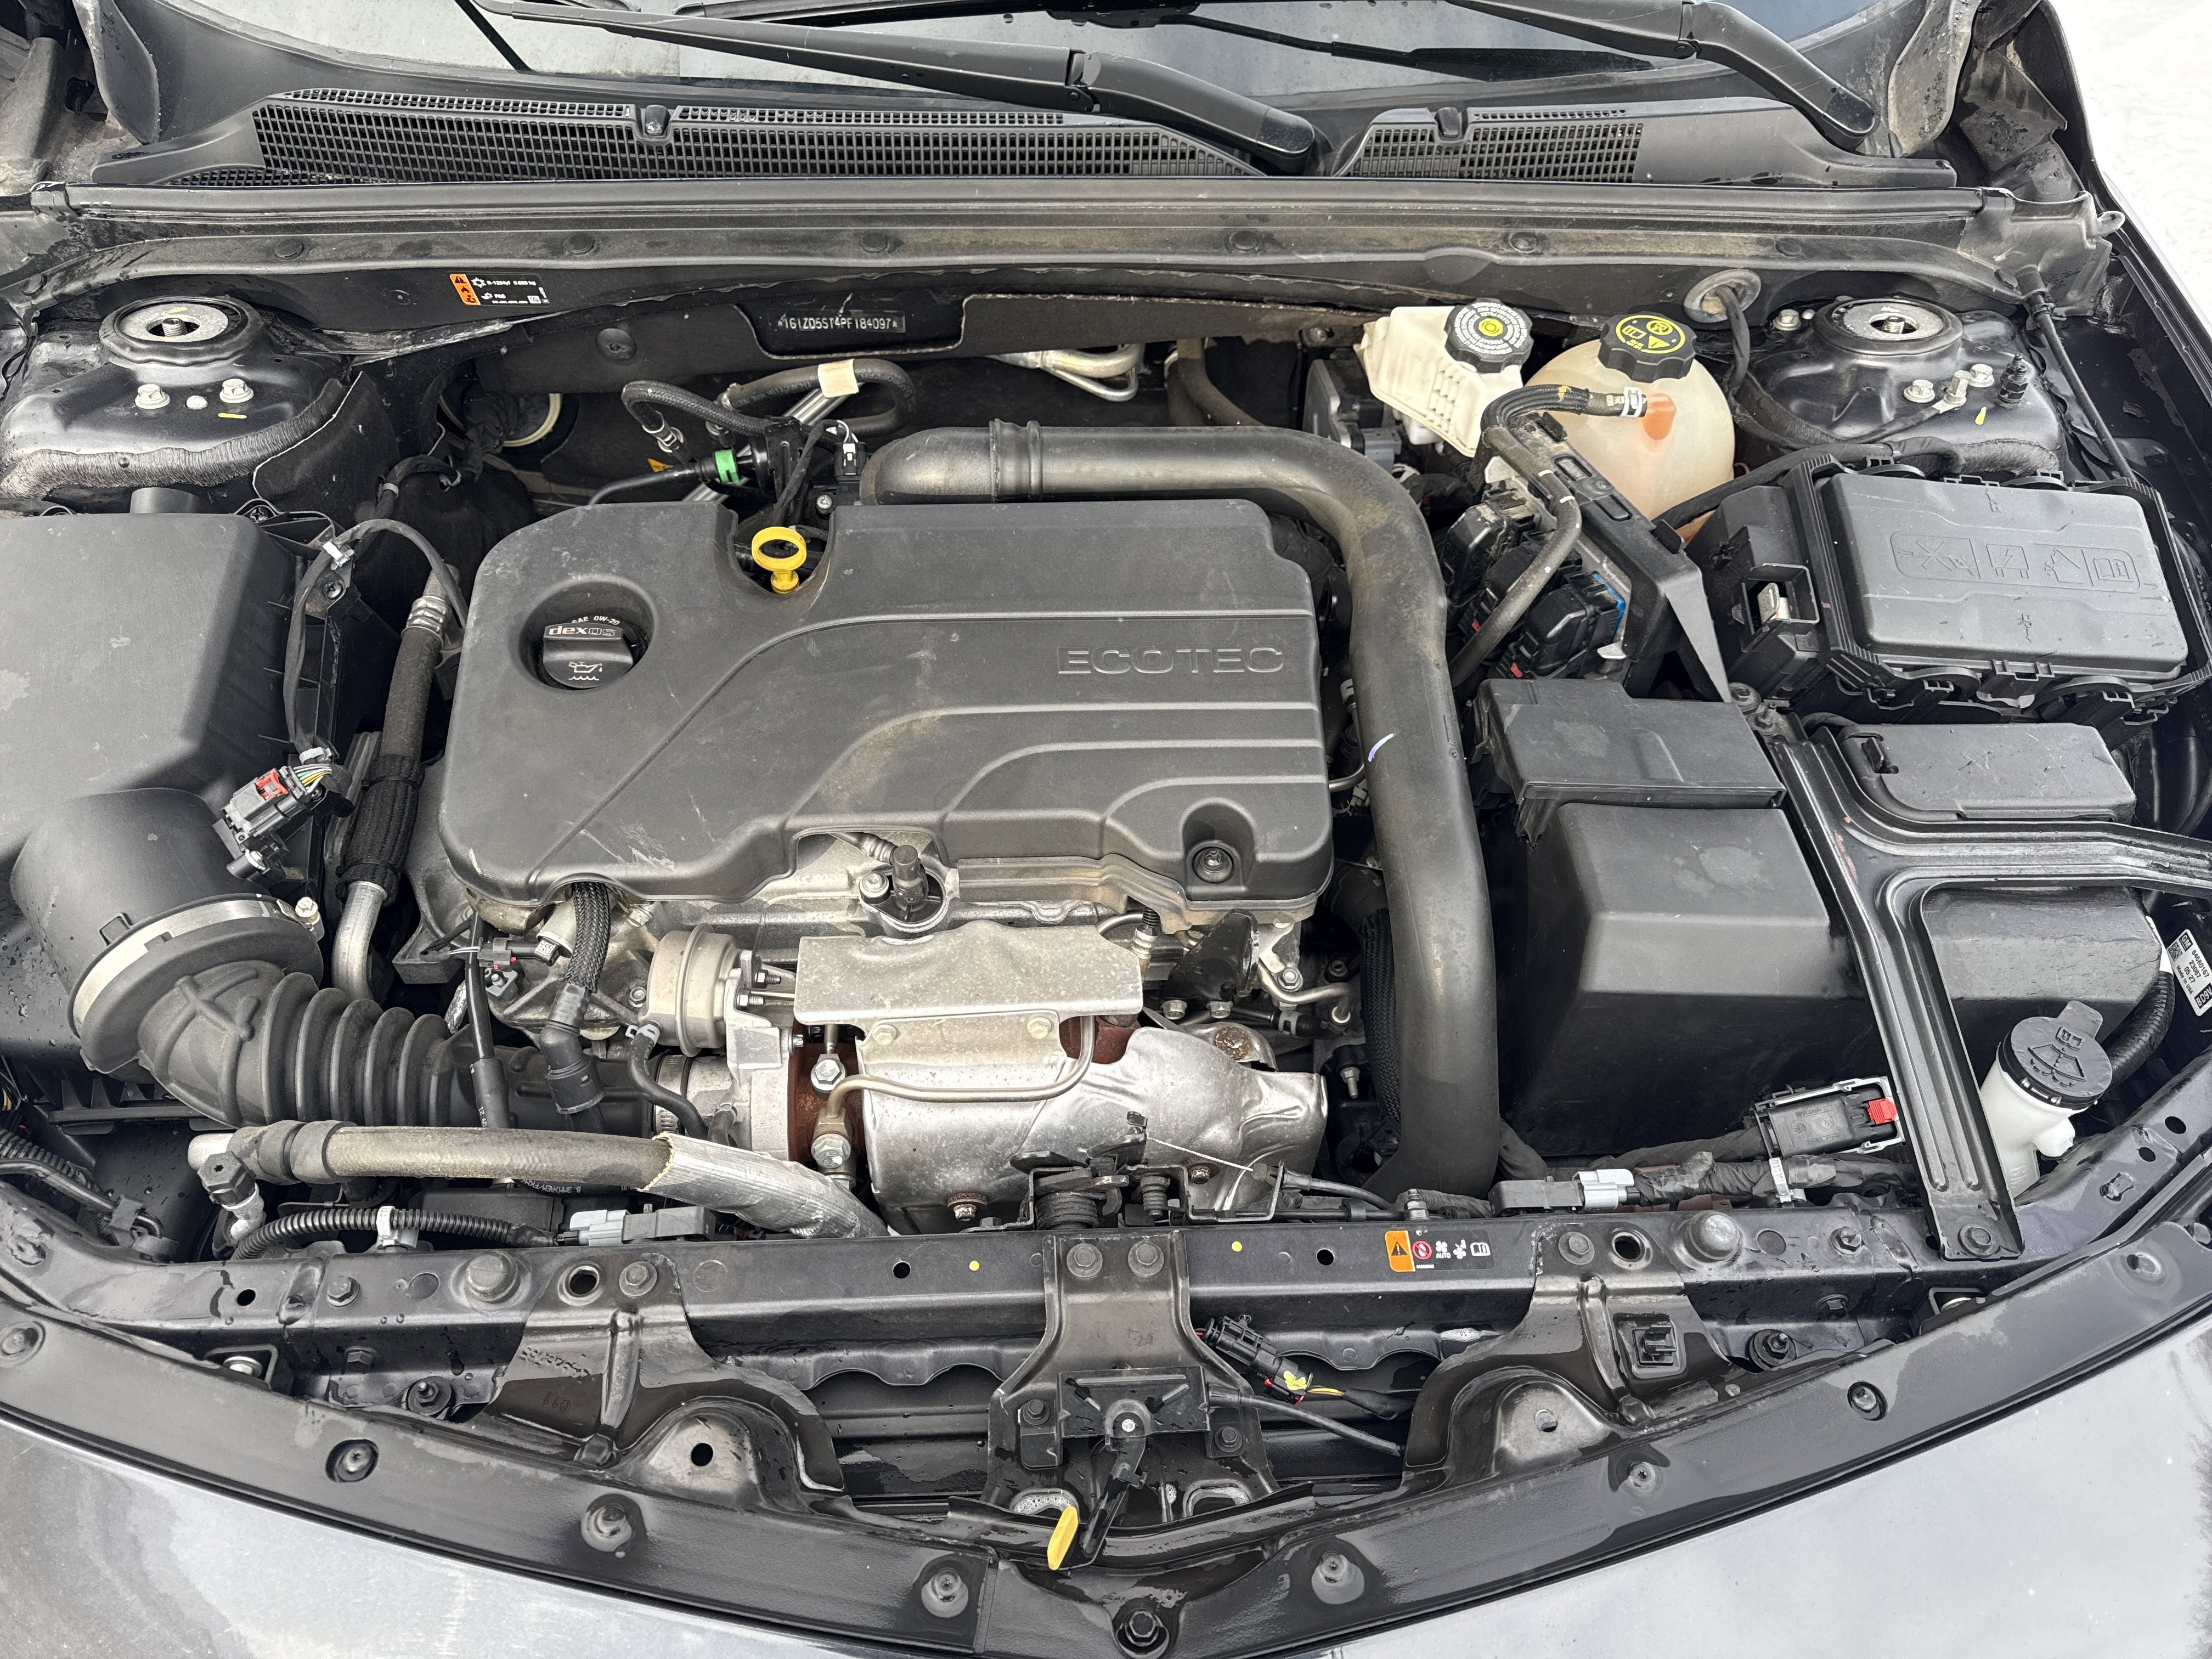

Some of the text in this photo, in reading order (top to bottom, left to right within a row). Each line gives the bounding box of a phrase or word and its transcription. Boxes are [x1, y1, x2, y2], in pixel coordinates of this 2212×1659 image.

[593, 616, 620, 625] 0W-20
[549, 626, 616, 637] dexos
[1058, 646, 1284, 674] ECOTEC
[2181, 934, 2192, 949] GM
[2189, 960, 2201, 978] 23067
[2191, 949, 2210, 978] 84680167
